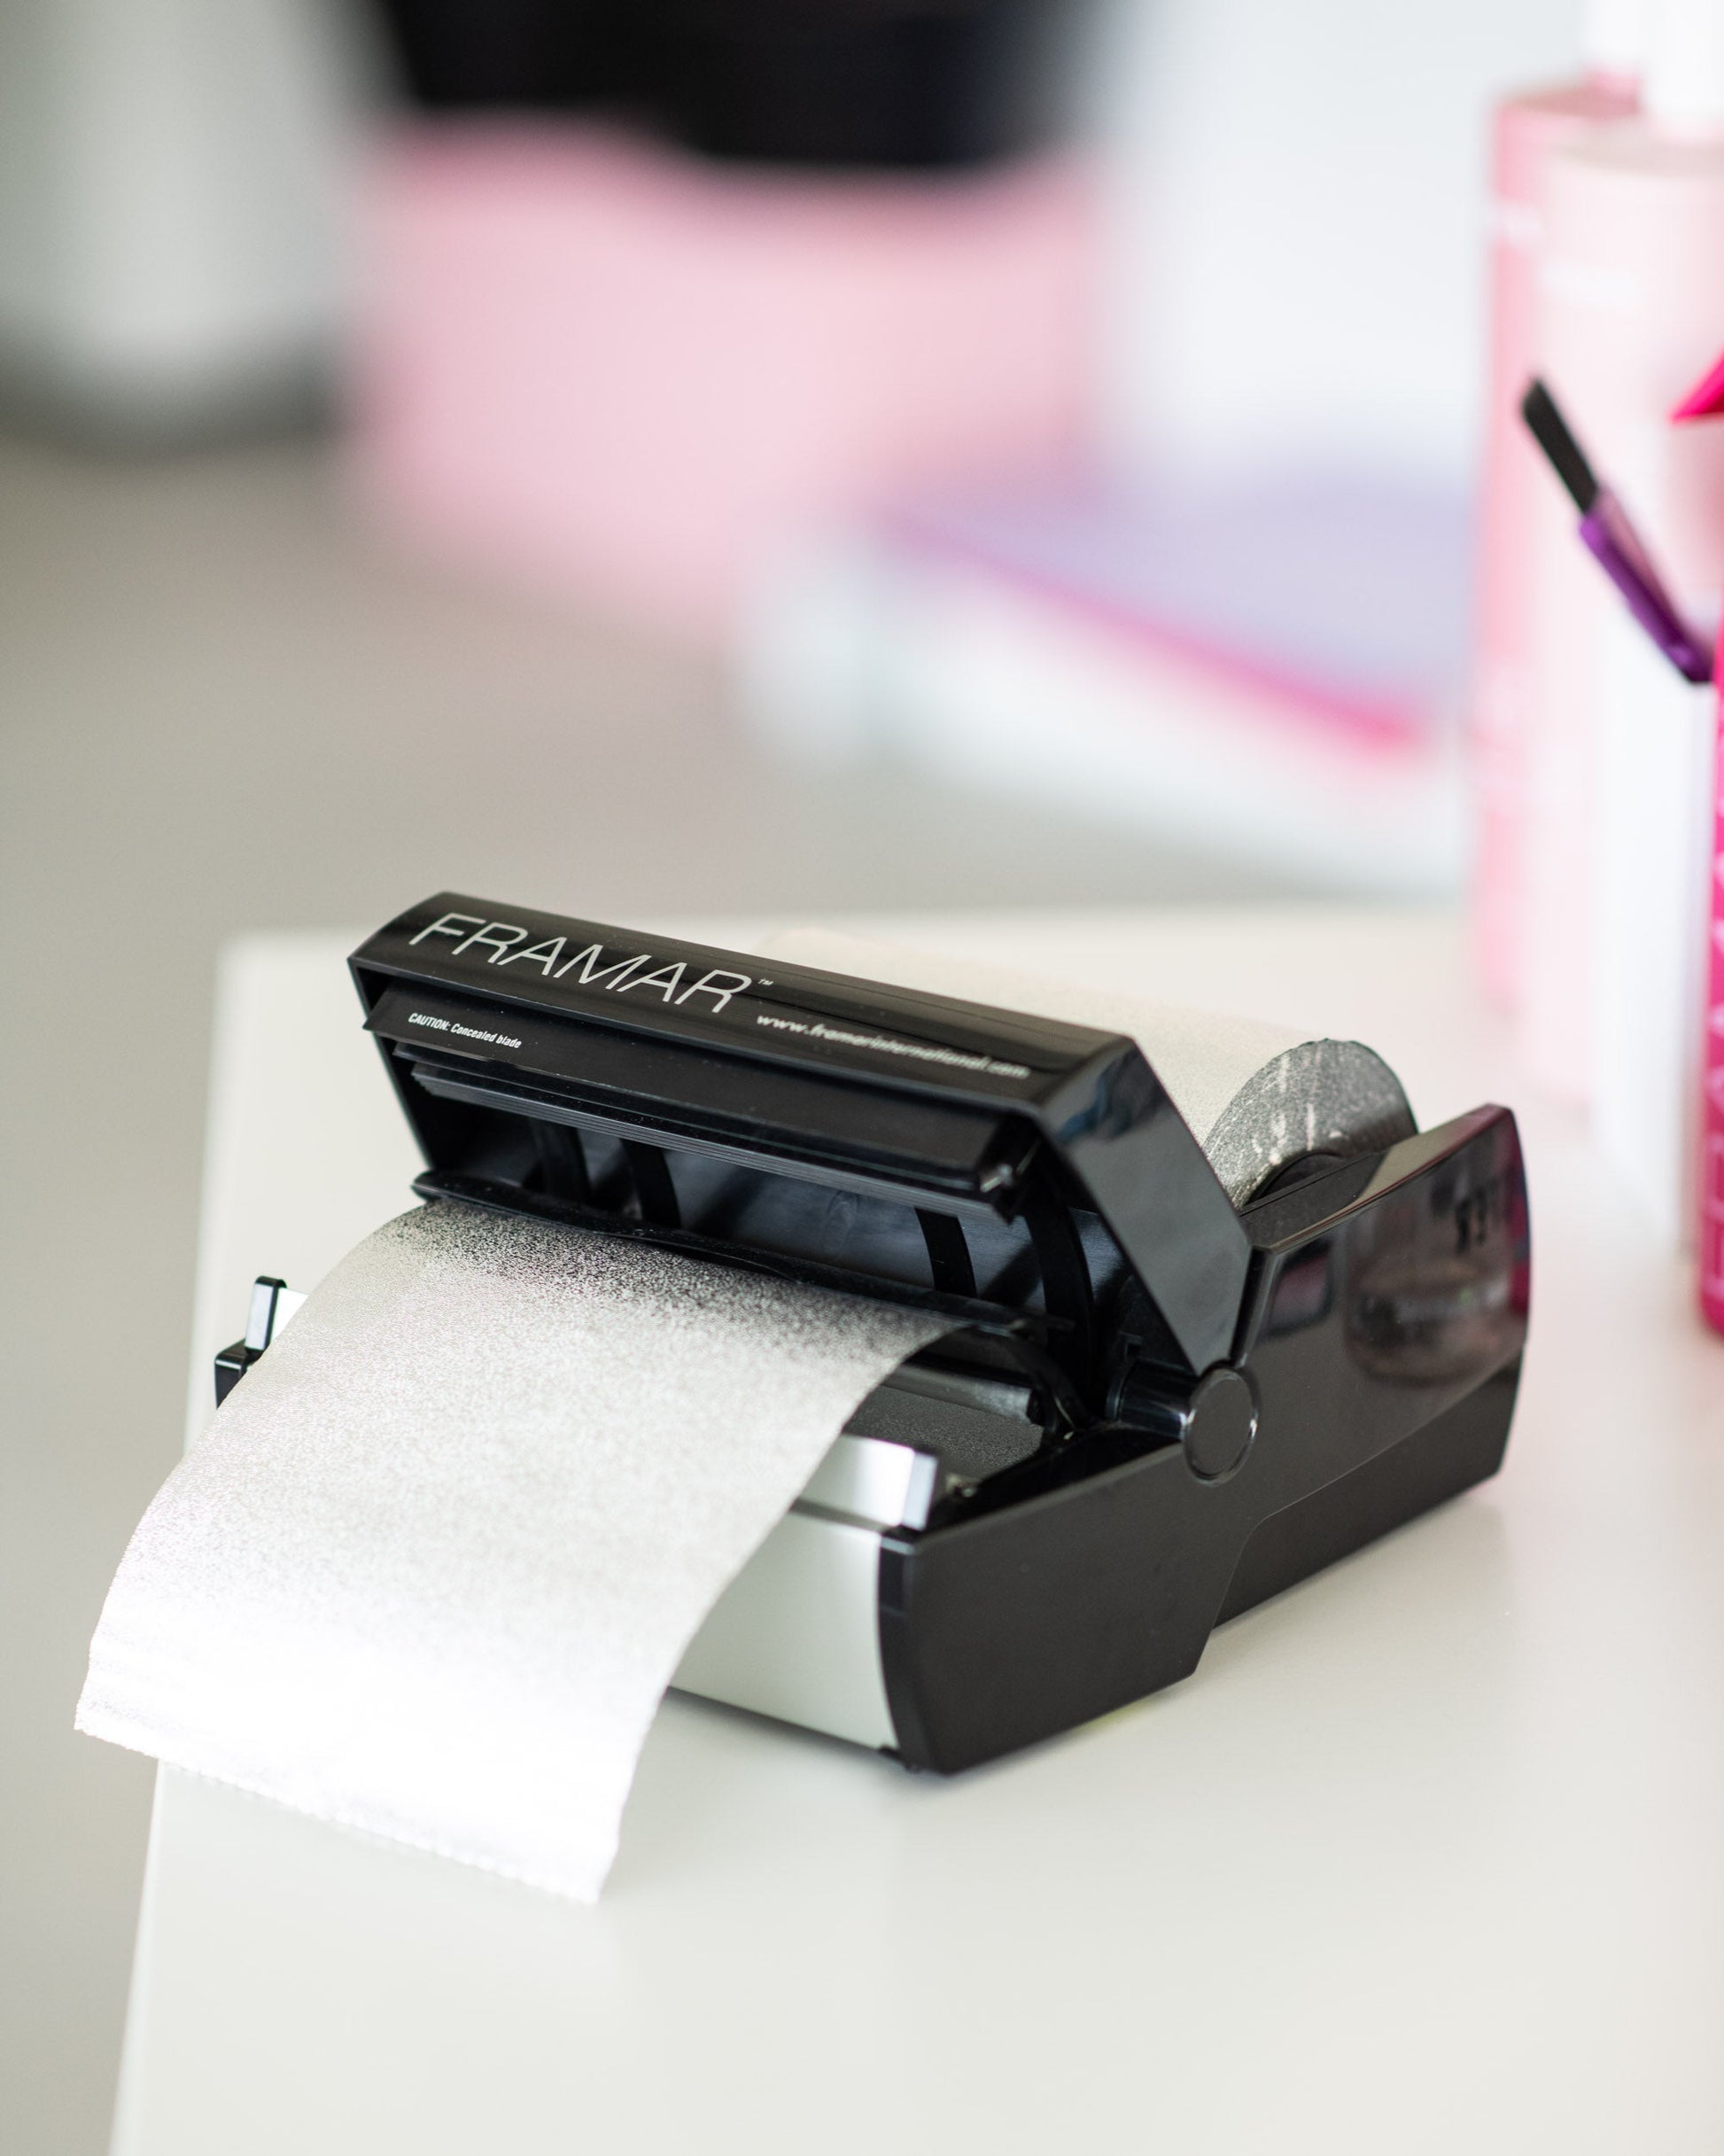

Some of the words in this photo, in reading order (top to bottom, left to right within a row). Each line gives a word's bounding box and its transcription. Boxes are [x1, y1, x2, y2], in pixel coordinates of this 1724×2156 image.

[408, 1013, 451, 1031] CAUTION:
[450, 1024, 498, 1042] Concealed
[496, 1035, 522, 1048] blade
[757, 1015, 1030, 1079] www.framarinternational.com
